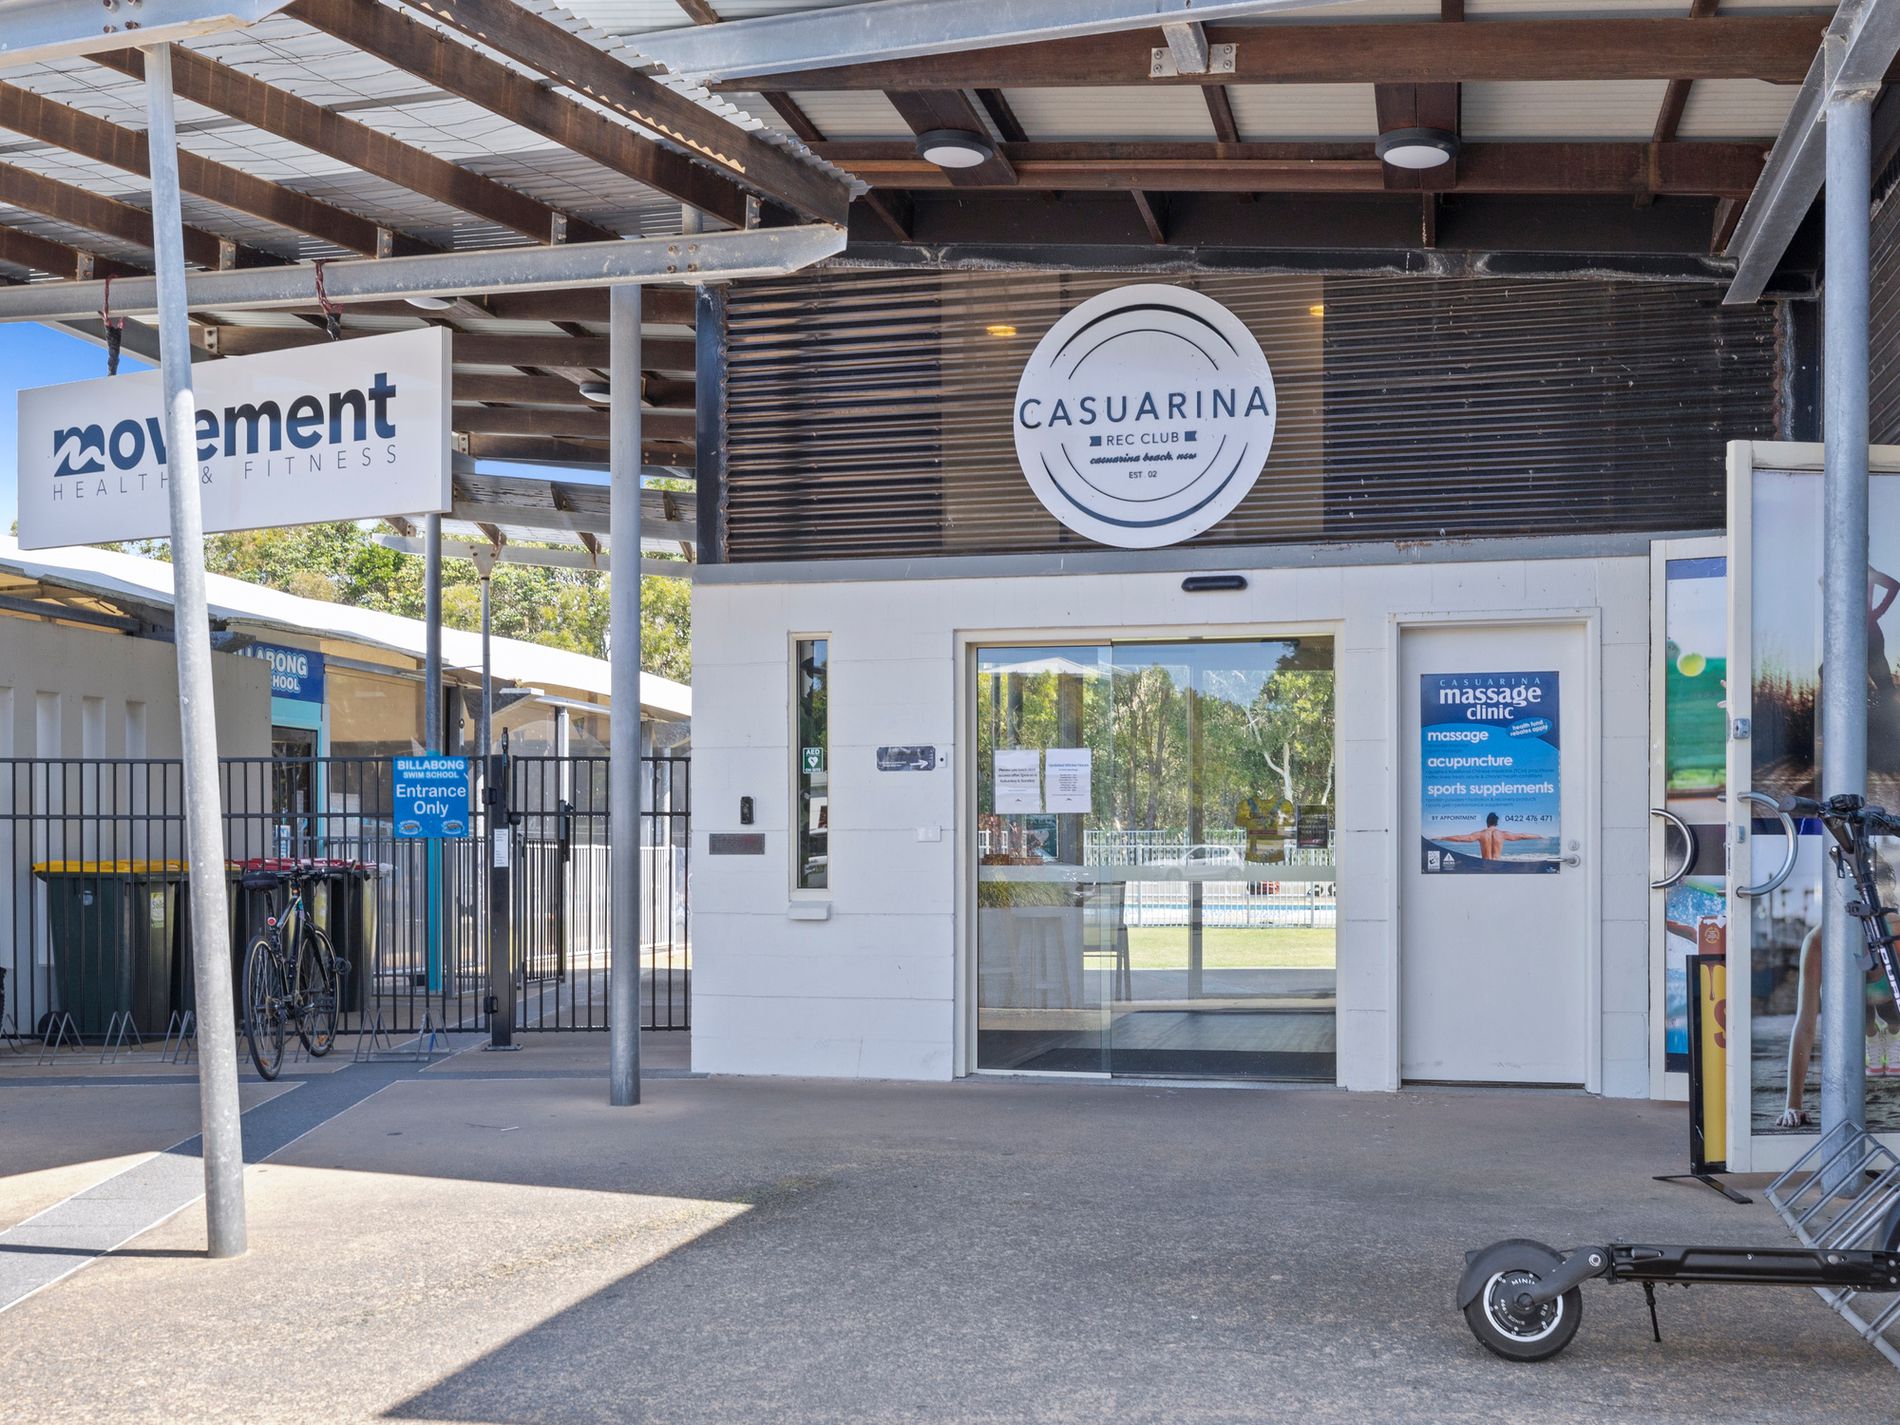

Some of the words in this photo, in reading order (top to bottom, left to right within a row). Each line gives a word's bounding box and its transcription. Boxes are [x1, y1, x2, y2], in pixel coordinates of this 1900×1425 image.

[1019, 386, 1270, 429] CASUARINA
[54, 372, 396, 477] movement
[1106, 433, 1135, 446] REC
[1140, 431, 1179, 445] CLUB
[1089, 453, 1141, 464] casuarina
[53, 472, 168, 500] HEALTH
[201, 465, 213, 484] &
[244, 444, 396, 480] FITNESS
[1128, 471, 1142, 479] EST
[1147, 470, 1158, 478] 02
[1440, 677, 1541, 687] CASUARINA
[1440, 685, 1542, 707] massage
[1466, 705, 1514, 720] clinic
[1427, 731, 1489, 743] massage
[397, 760, 465, 771] BILLABONG
[1427, 754, 1513, 769] acupuncture
[403, 771, 425, 779] SWIM
[425, 771, 460, 779] SCHOOL
[396, 783, 466, 798] Entrance
[1427, 782, 1467, 797] sports
[1469, 781, 1554, 797] supplements
[413, 800, 449, 818] Only
